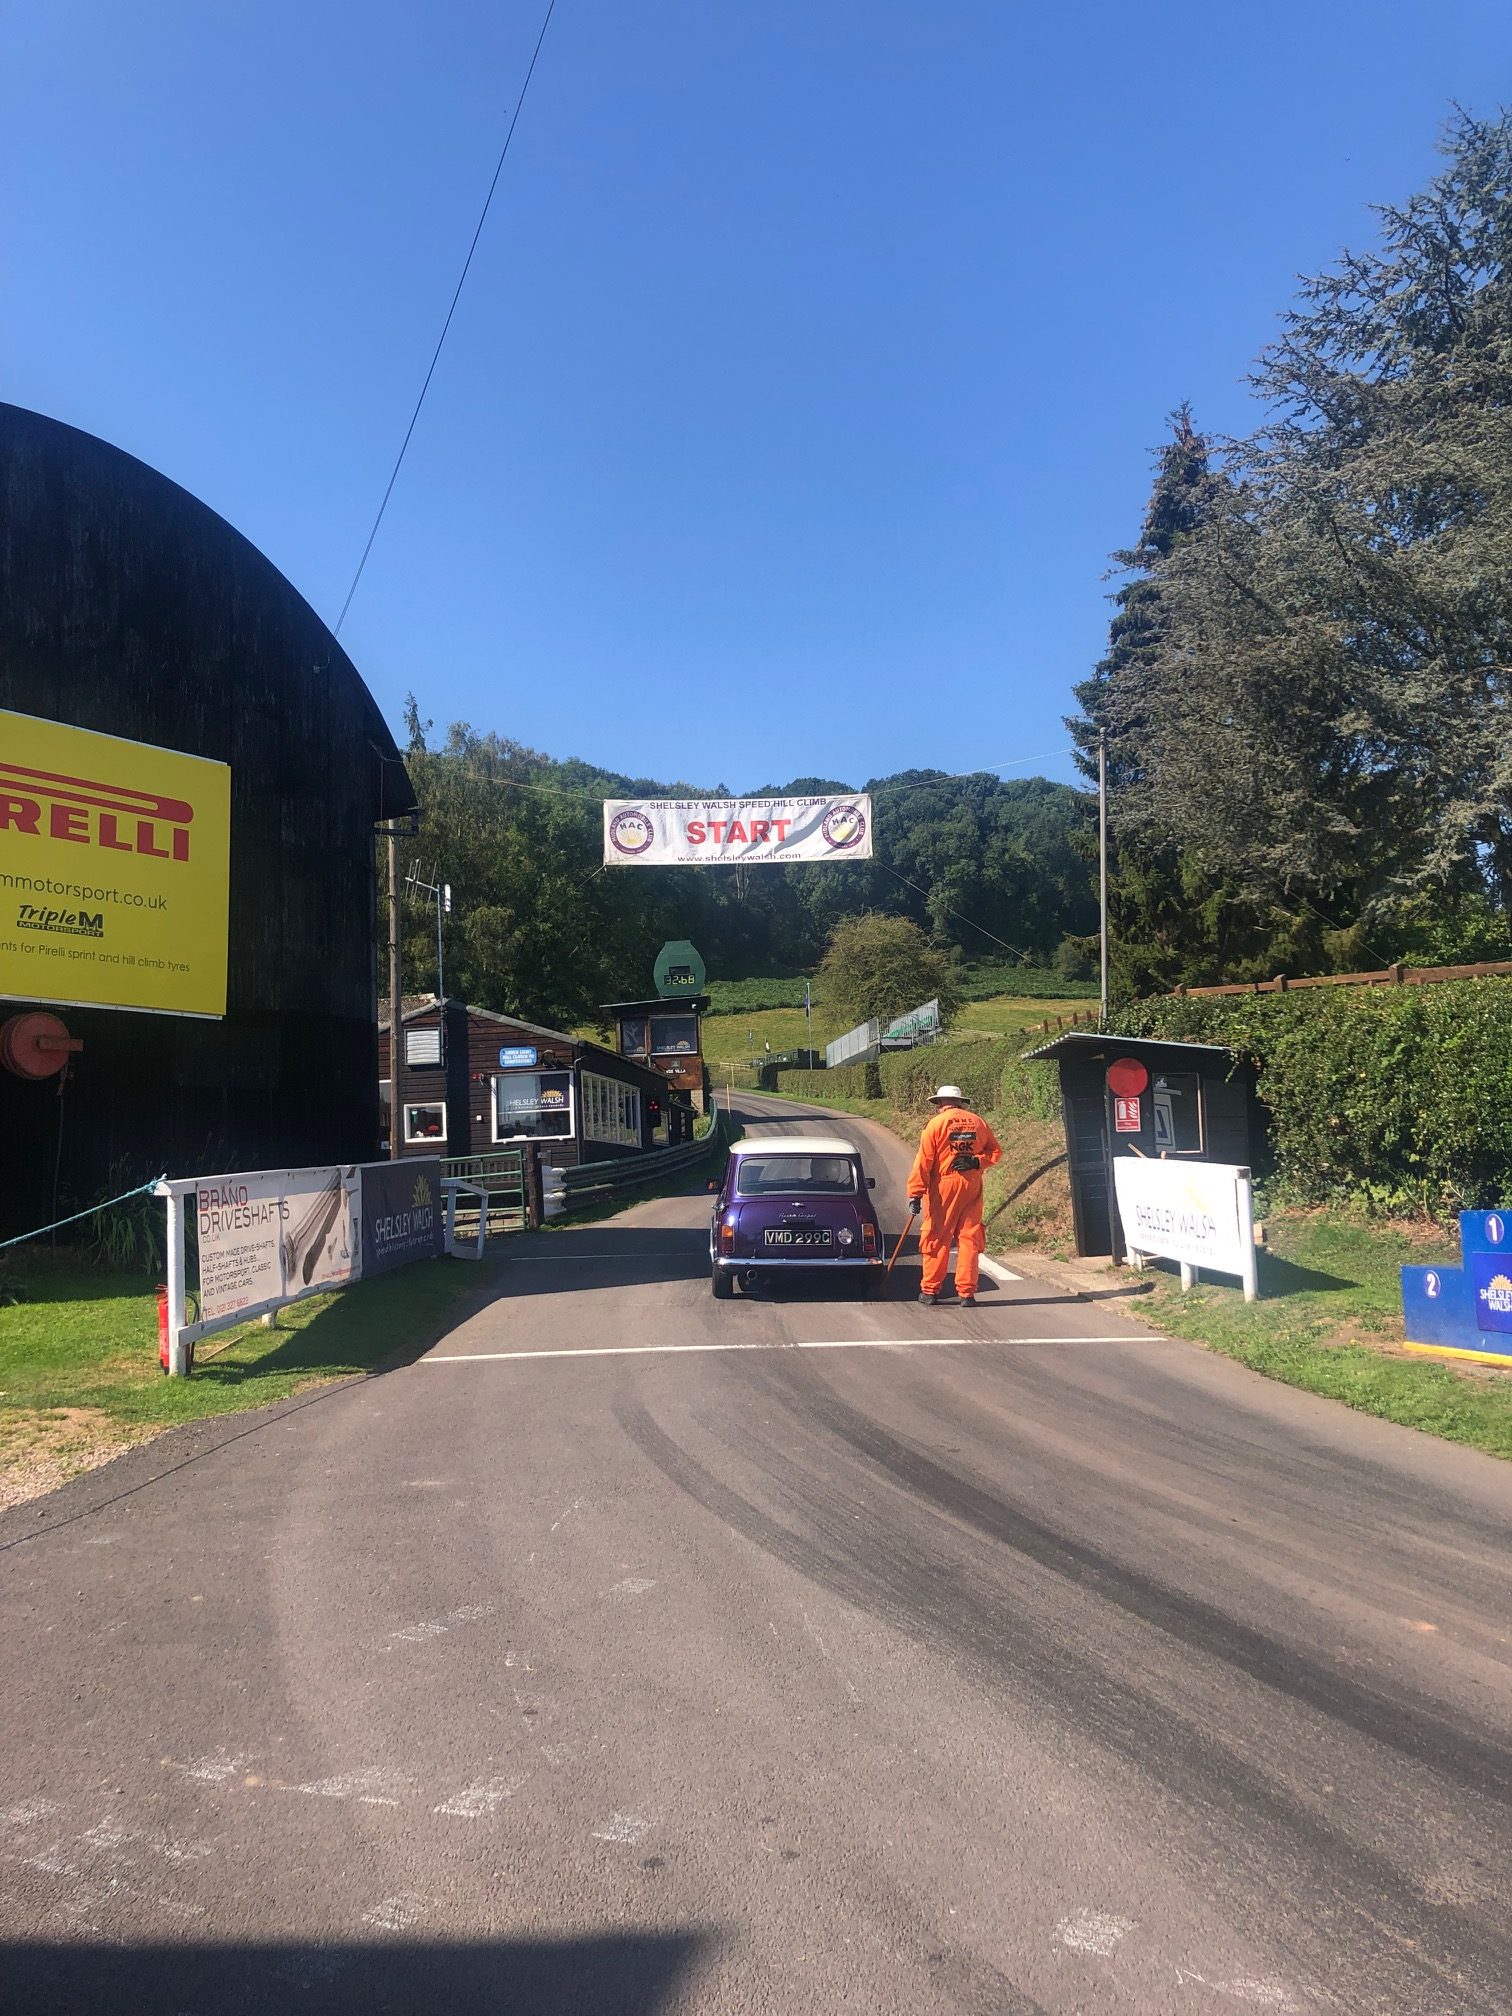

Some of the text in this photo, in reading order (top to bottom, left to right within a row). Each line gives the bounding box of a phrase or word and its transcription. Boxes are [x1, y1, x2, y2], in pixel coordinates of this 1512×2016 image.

[650, 797, 827, 810] SHELSLEY WALSH SPEED HILL CLIMB
[832, 805, 863, 820] AUTOMOBILE
[686, 819, 792, 845] START
[678, 853, 801, 863] www.shelsleywalsh.com
[19, 921, 103, 938] MOTORSPORT
[21, 942, 36, 955] for
[39, 944, 66, 958] Pirelli
[68, 949, 96, 961] sprint
[98, 952, 120, 964] and
[122, 954, 136, 966] hill
[137, 957, 166, 969] climb
[168, 960, 190, 973] tyres
[665, 975, 695, 985] 32.68
[540, 1095, 564, 1104] WALSH
[949, 1141, 974, 1152] NGK
[199, 1185, 248, 1212] BRAND
[200, 1200, 290, 1236] DRIVESHAFTS
[375, 1207, 434, 1244] SHELSLEY WALSH
[1136, 1204, 1216, 1239] SHELSLEY WALSH
[766, 1232, 792, 1244] VMD
[1488, 1217, 1498, 1242] 1
[201, 1250, 225, 1263] CUSTOM
[226, 1247, 240, 1258] MADE
[202, 1276, 214, 1286] FOR
[251, 1261, 272, 1274] CLASSIC
[203, 1287, 215, 1298] AND
[215, 1281, 238, 1295] VINTAGE
[1426, 1273, 1436, 1296] 2
[1488, 1299, 1512, 1312] WALSH
